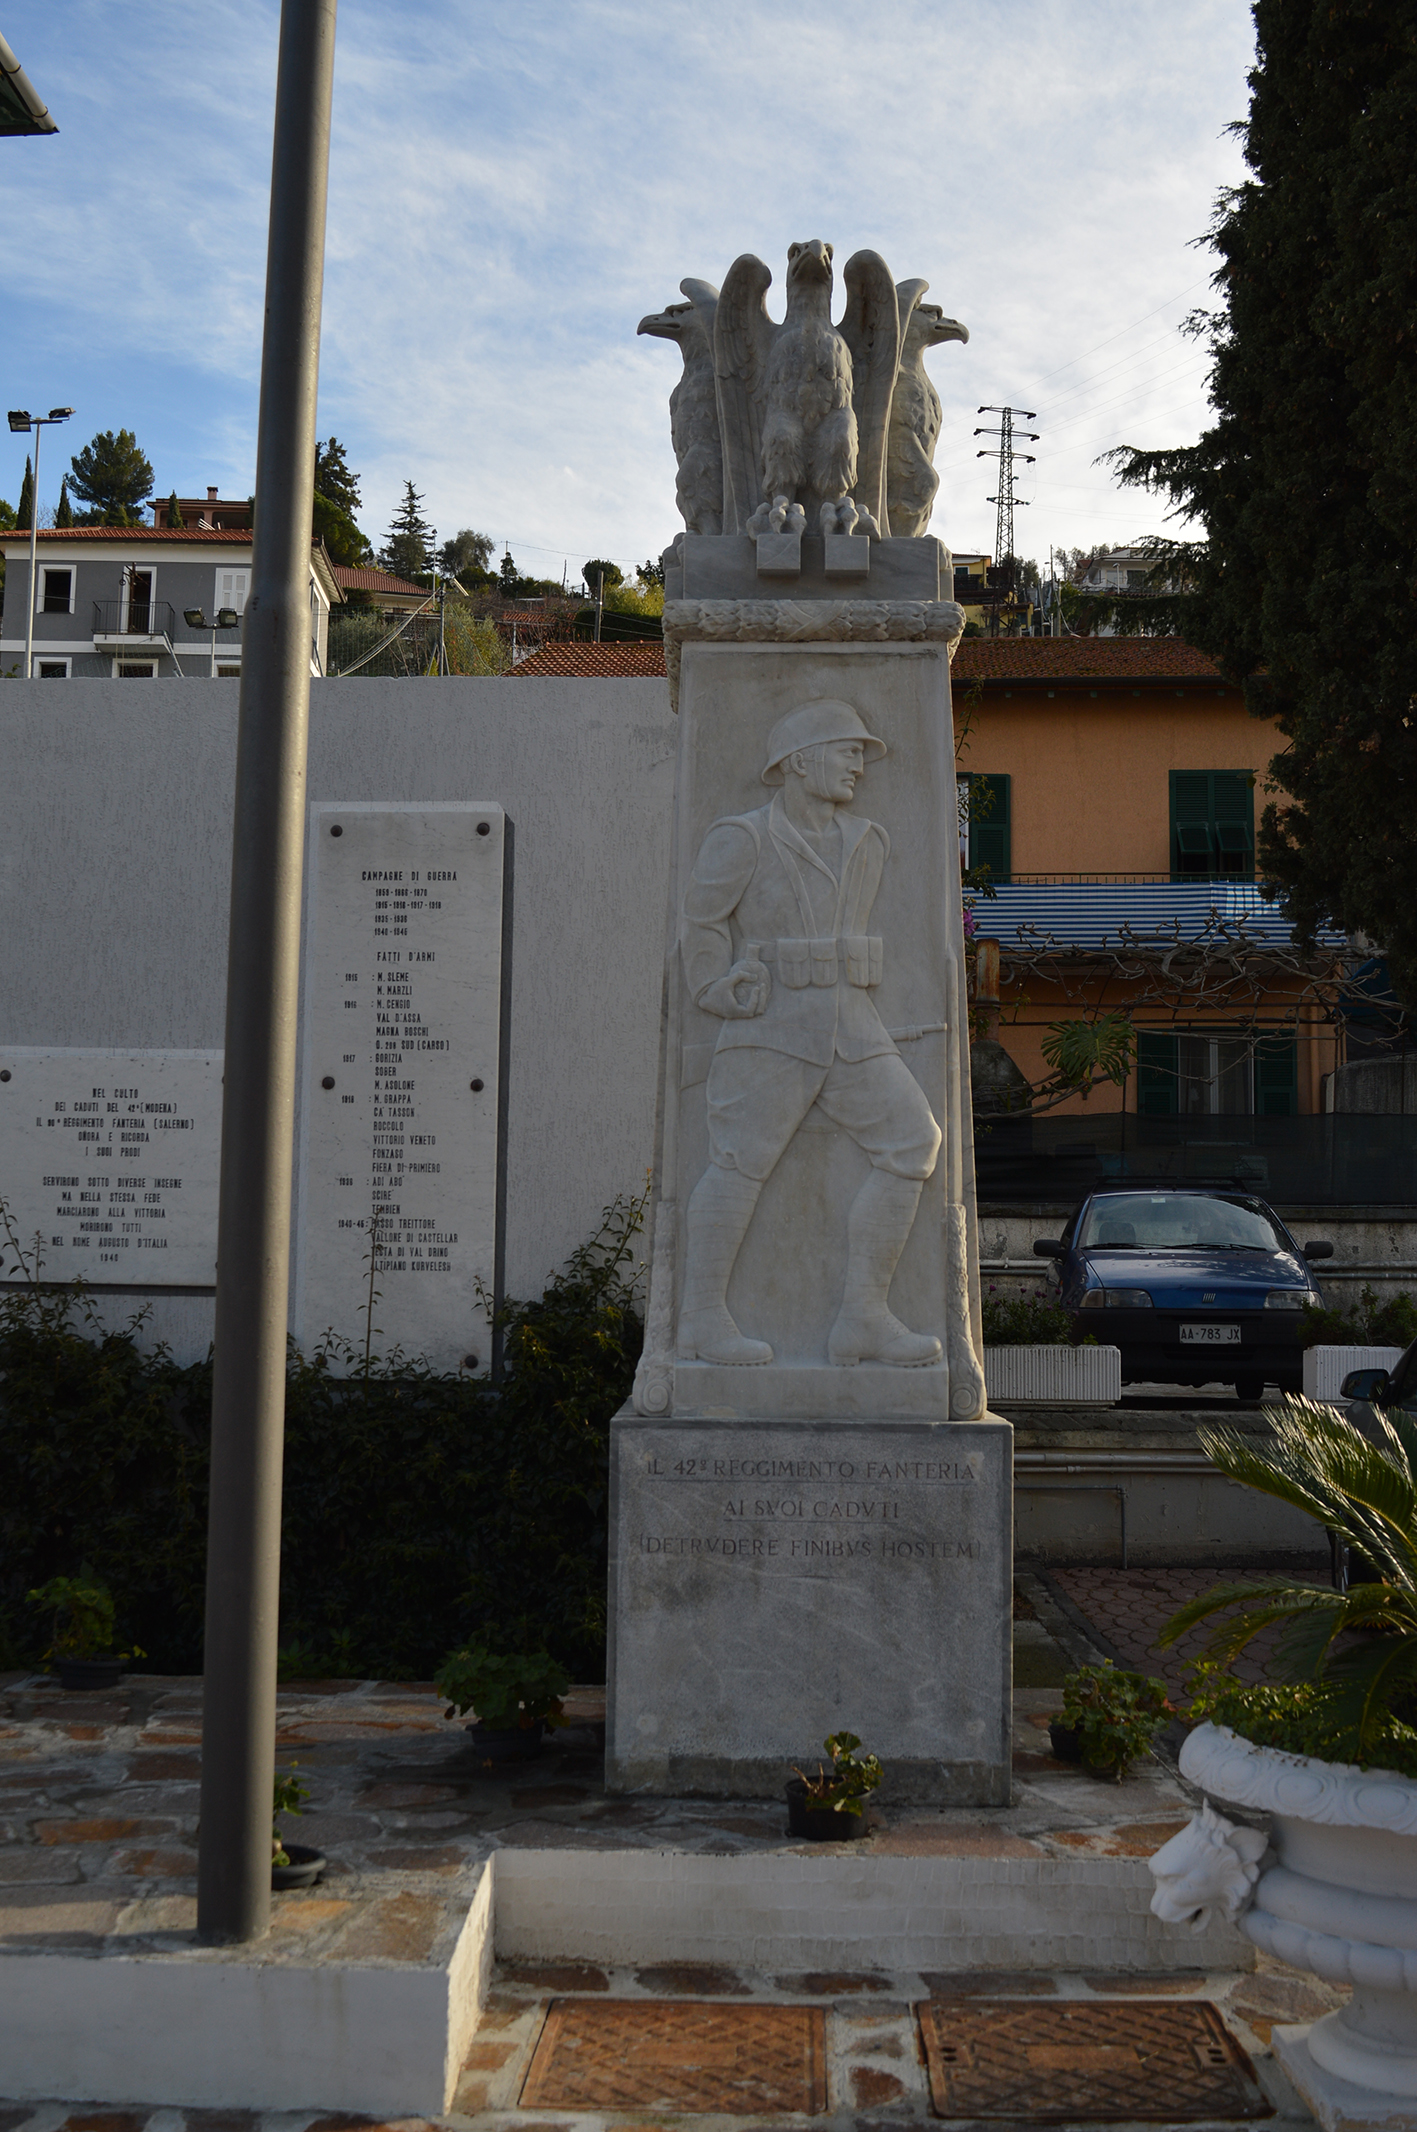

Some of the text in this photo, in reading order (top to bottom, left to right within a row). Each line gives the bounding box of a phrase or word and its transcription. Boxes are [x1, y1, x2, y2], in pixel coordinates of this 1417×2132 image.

[362, 871, 457, 881] CAMPAGNE DI GUERRA
[377, 952, 400, 961] FATTI
[387, 972, 409, 981] SLEME
[387, 986, 412, 995] MARZLI
[387, 1000, 410, 1009] CENGIO
[377, 1013, 390, 1022] VAL
[376, 1027, 429, 1036] MAGNA BOSCHI
[401, 1041, 414, 1049] SUD
[375, 1053, 403, 1063] GORIZIA
[375, 1067, 396, 1077] SOBER
[385, 1080, 415, 1090] ASOLONE
[92, 1088, 139, 1099] NEL CULTO
[384, 1095, 411, 1104] GRAPPA
[55, 1102, 66, 1112] DEI
[74, 1102, 99, 1112] CADUTI
[107, 1103, 119, 1112] DEL
[389, 1108, 415, 1117] TASSON
[36, 1117, 42, 1127] IL
[63, 1118, 104, 1128] REGGIMENTO
[113, 1119, 145, 1128] FANTERIA
[373, 1121, 404, 1131] ROCCOLO
[109, 1132, 112, 1141] E
[121, 1132, 150, 1142] RICORDA
[373, 1135, 436, 1145] VITTORIO VENETO
[97, 1147, 112, 1156] SUOI
[121, 1147, 140, 1157] PRODI
[372, 1149, 403, 1159] FONZASO
[372, 1163, 440, 1173] FIERA DI PRIMIERO
[42, 1176, 182, 1188] SERVIRONO SOTTO DIVERSE INSEGNE
[372, 1177, 384, 1186] ADI
[62, 1192, 161, 1203] MA NELLA STESSA FEDE
[57, 1207, 165, 1218] MARCIARONO ALLA VITTORIA
[80, 1222, 141, 1233] MORIRONO TUTTI
[399, 1219, 435, 1229] TREITTORE
[52, 1236, 64, 1246] NEL
[73, 1237, 90, 1247] NOME
[99, 1238, 129, 1248] AUGUSTO
[407, 1233, 413, 1243] DI
[418, 1233, 458, 1243] CASTELLAR
[398, 1247, 404, 1257] DI
[410, 1248, 422, 1257] VAL
[428, 1248, 448, 1257] DRINO
[714, 1460, 855, 1479] REGGIMENTO
[867, 1462, 975, 1480] FANTERIA
[724, 1501, 744, 1516] AI
[791, 1540, 872, 1557] FINIBVS
